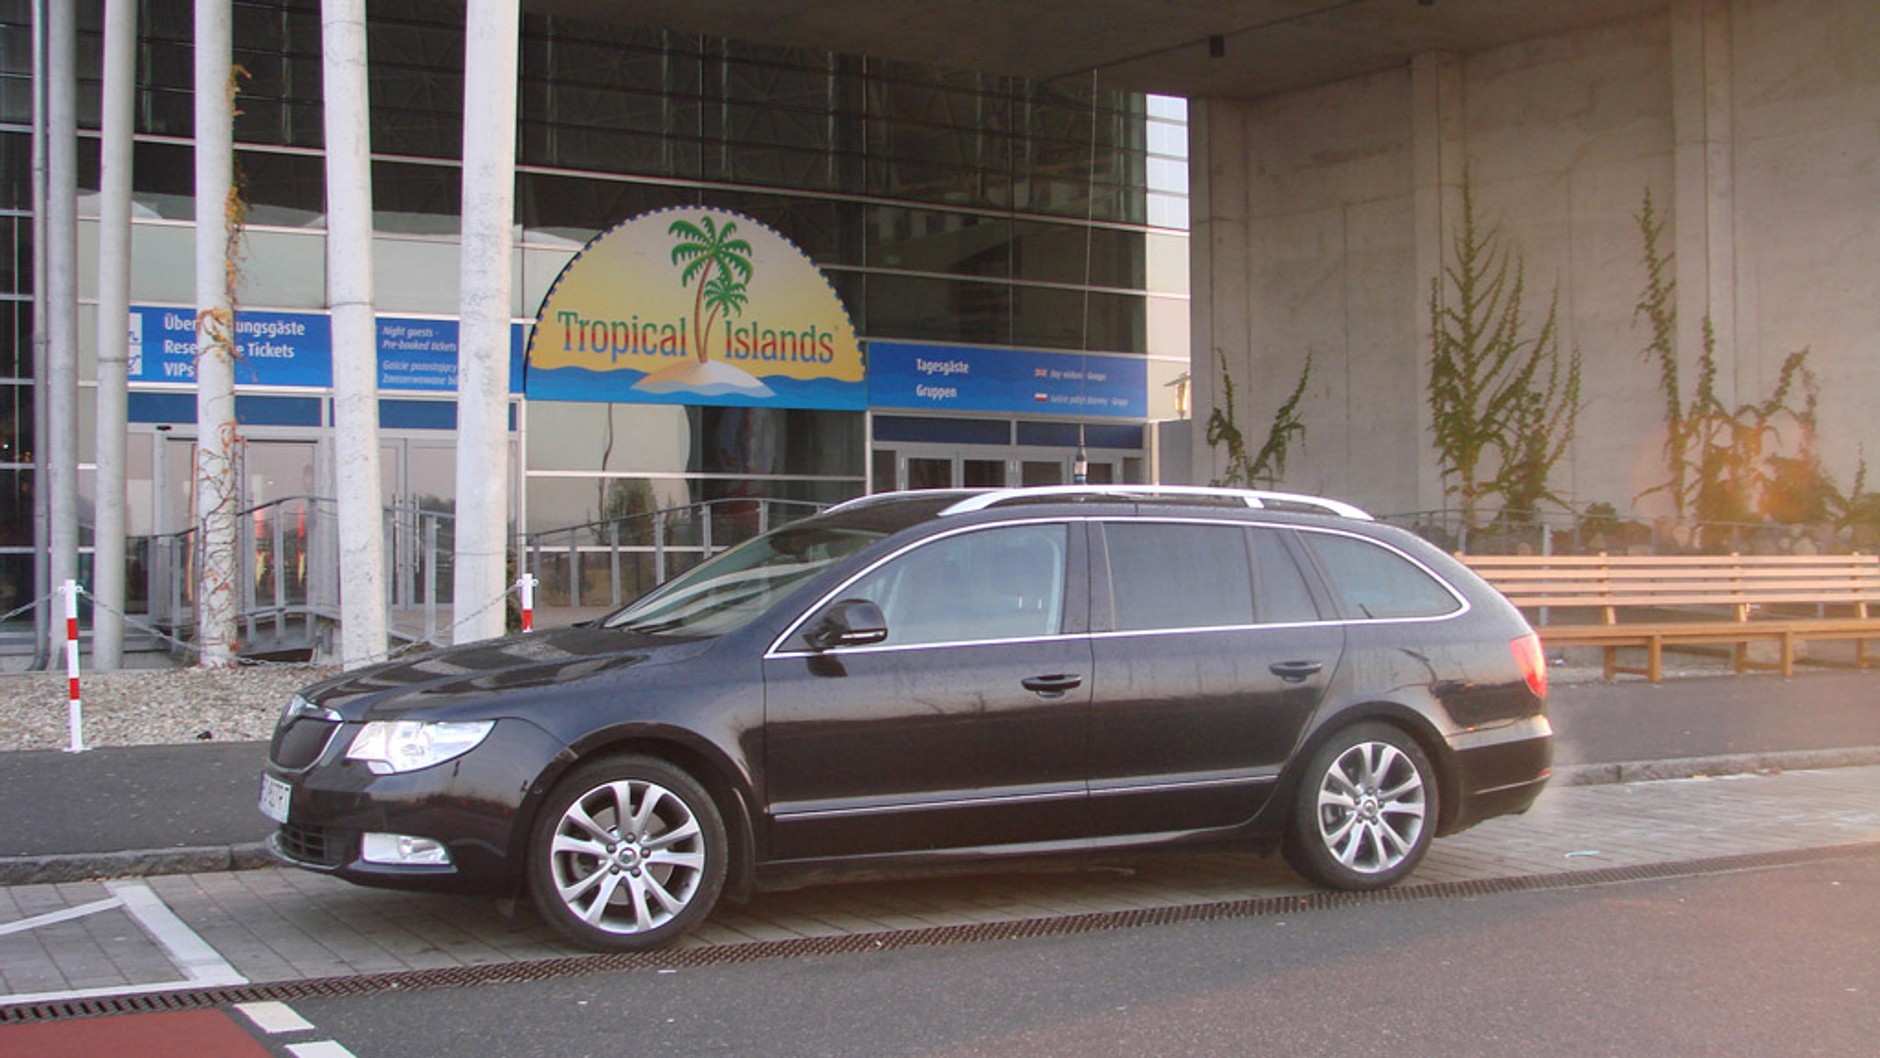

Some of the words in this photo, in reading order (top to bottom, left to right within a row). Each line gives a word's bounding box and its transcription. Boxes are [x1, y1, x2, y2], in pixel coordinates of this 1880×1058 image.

[163, 313, 305, 338] Überungsgäste
[557, 310, 687, 363] Tropical
[724, 319, 835, 363] Islands
[247, 342, 296, 359] Tickets
[163, 362, 195, 377] VIPs
[916, 358, 969, 376] Tagesgäste
[916, 384, 958, 401] Gruppen
